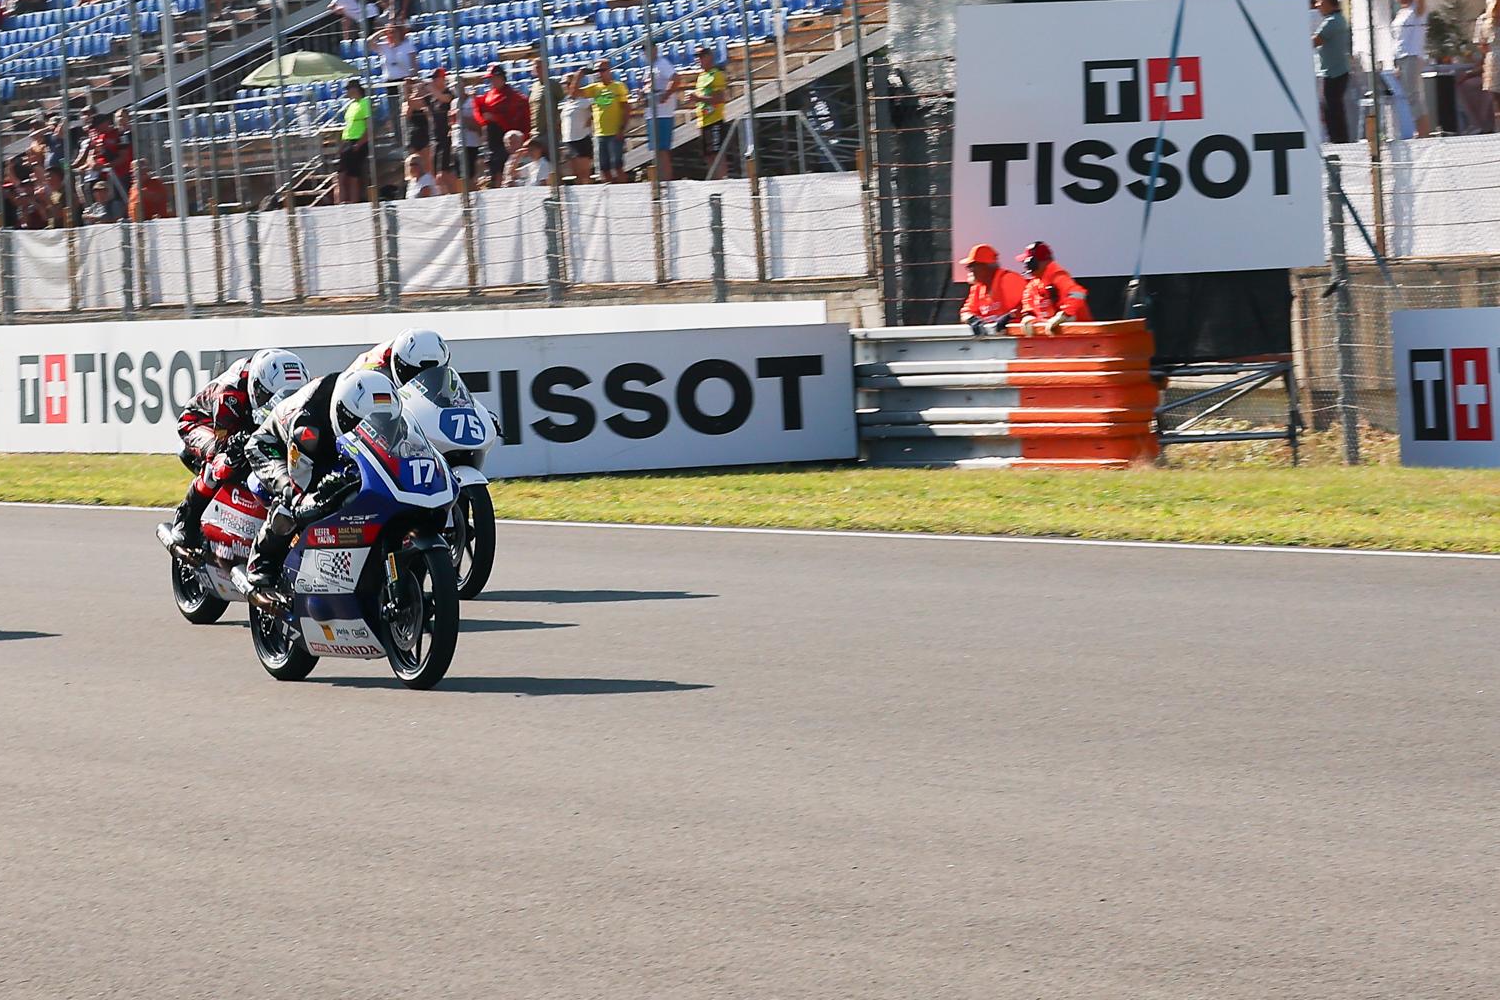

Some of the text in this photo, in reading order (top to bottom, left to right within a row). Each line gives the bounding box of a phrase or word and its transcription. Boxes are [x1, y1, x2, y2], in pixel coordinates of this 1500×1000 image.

[970, 132, 1305, 207] TISSOT
[451, 414, 484, 440] 75
[409, 459, 435, 486] 17
[314, 528, 331, 536] KIEFER
[317, 535, 336, 544] RACING
[330, 645, 382, 655] HONDA
